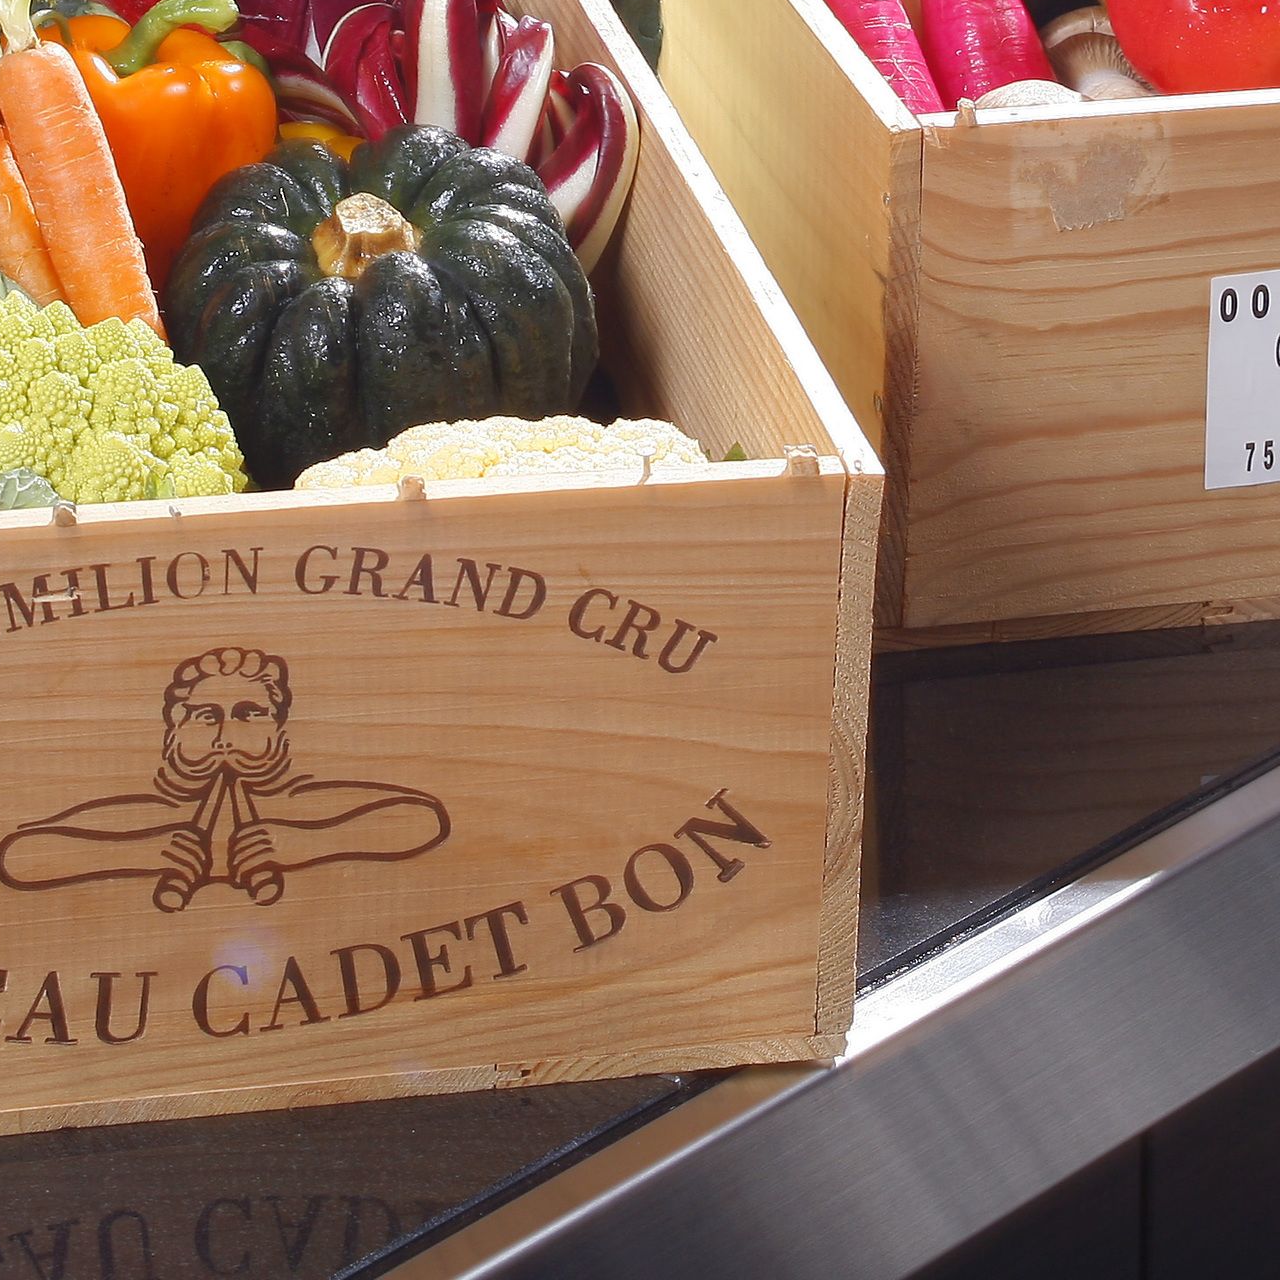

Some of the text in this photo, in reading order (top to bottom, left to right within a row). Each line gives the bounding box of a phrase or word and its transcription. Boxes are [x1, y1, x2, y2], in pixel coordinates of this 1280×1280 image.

[294, 544, 547, 620] GRAND
[567, 587, 718, 675] CRU
[191, 900, 529, 1039] CADET
[549, 787, 773, 953] BON
